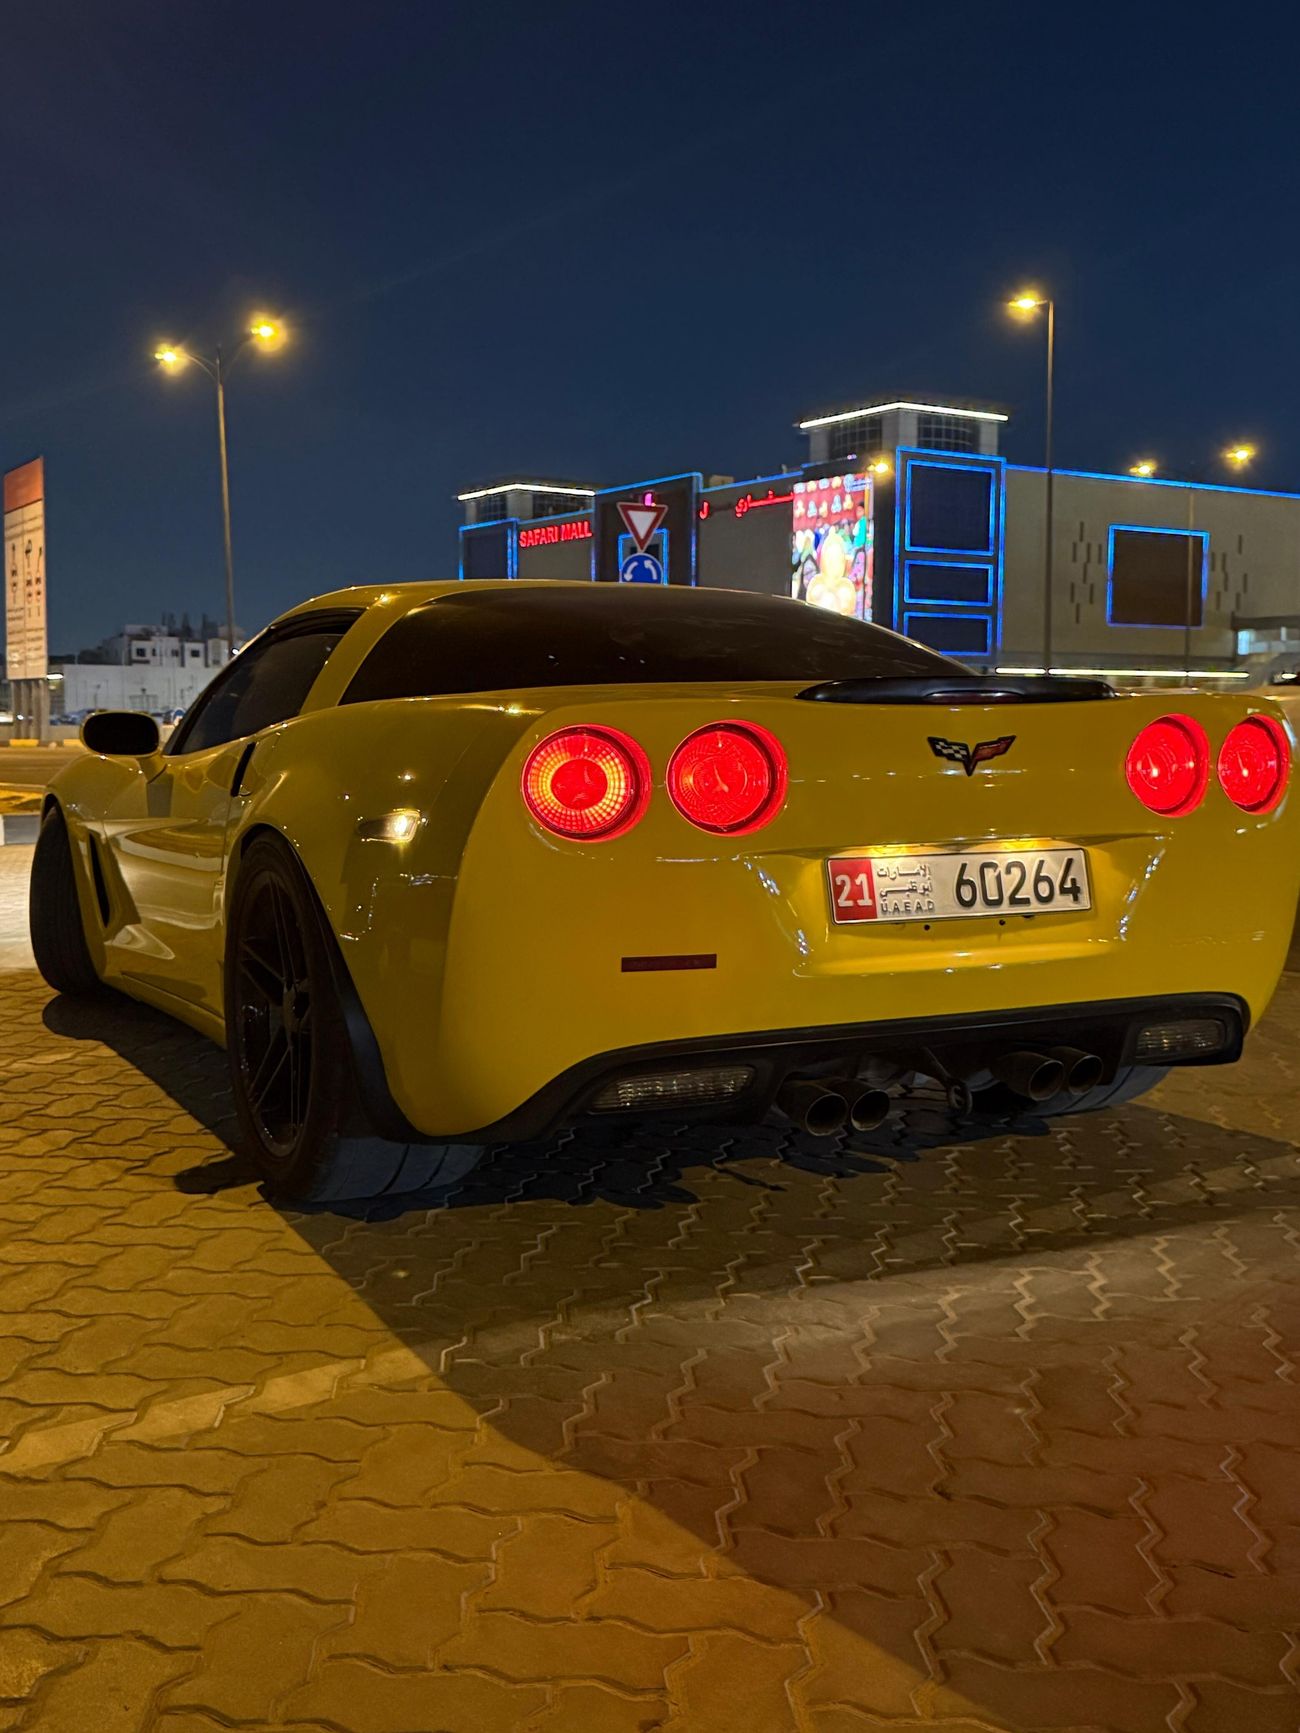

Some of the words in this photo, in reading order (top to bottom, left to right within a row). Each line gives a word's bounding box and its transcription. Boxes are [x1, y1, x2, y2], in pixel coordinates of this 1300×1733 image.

[519, 526, 558, 548] SAFARI
[561, 521, 592, 541] MALL
[836, 874, 873, 907] 21
[955, 857, 1081, 907] 60264
